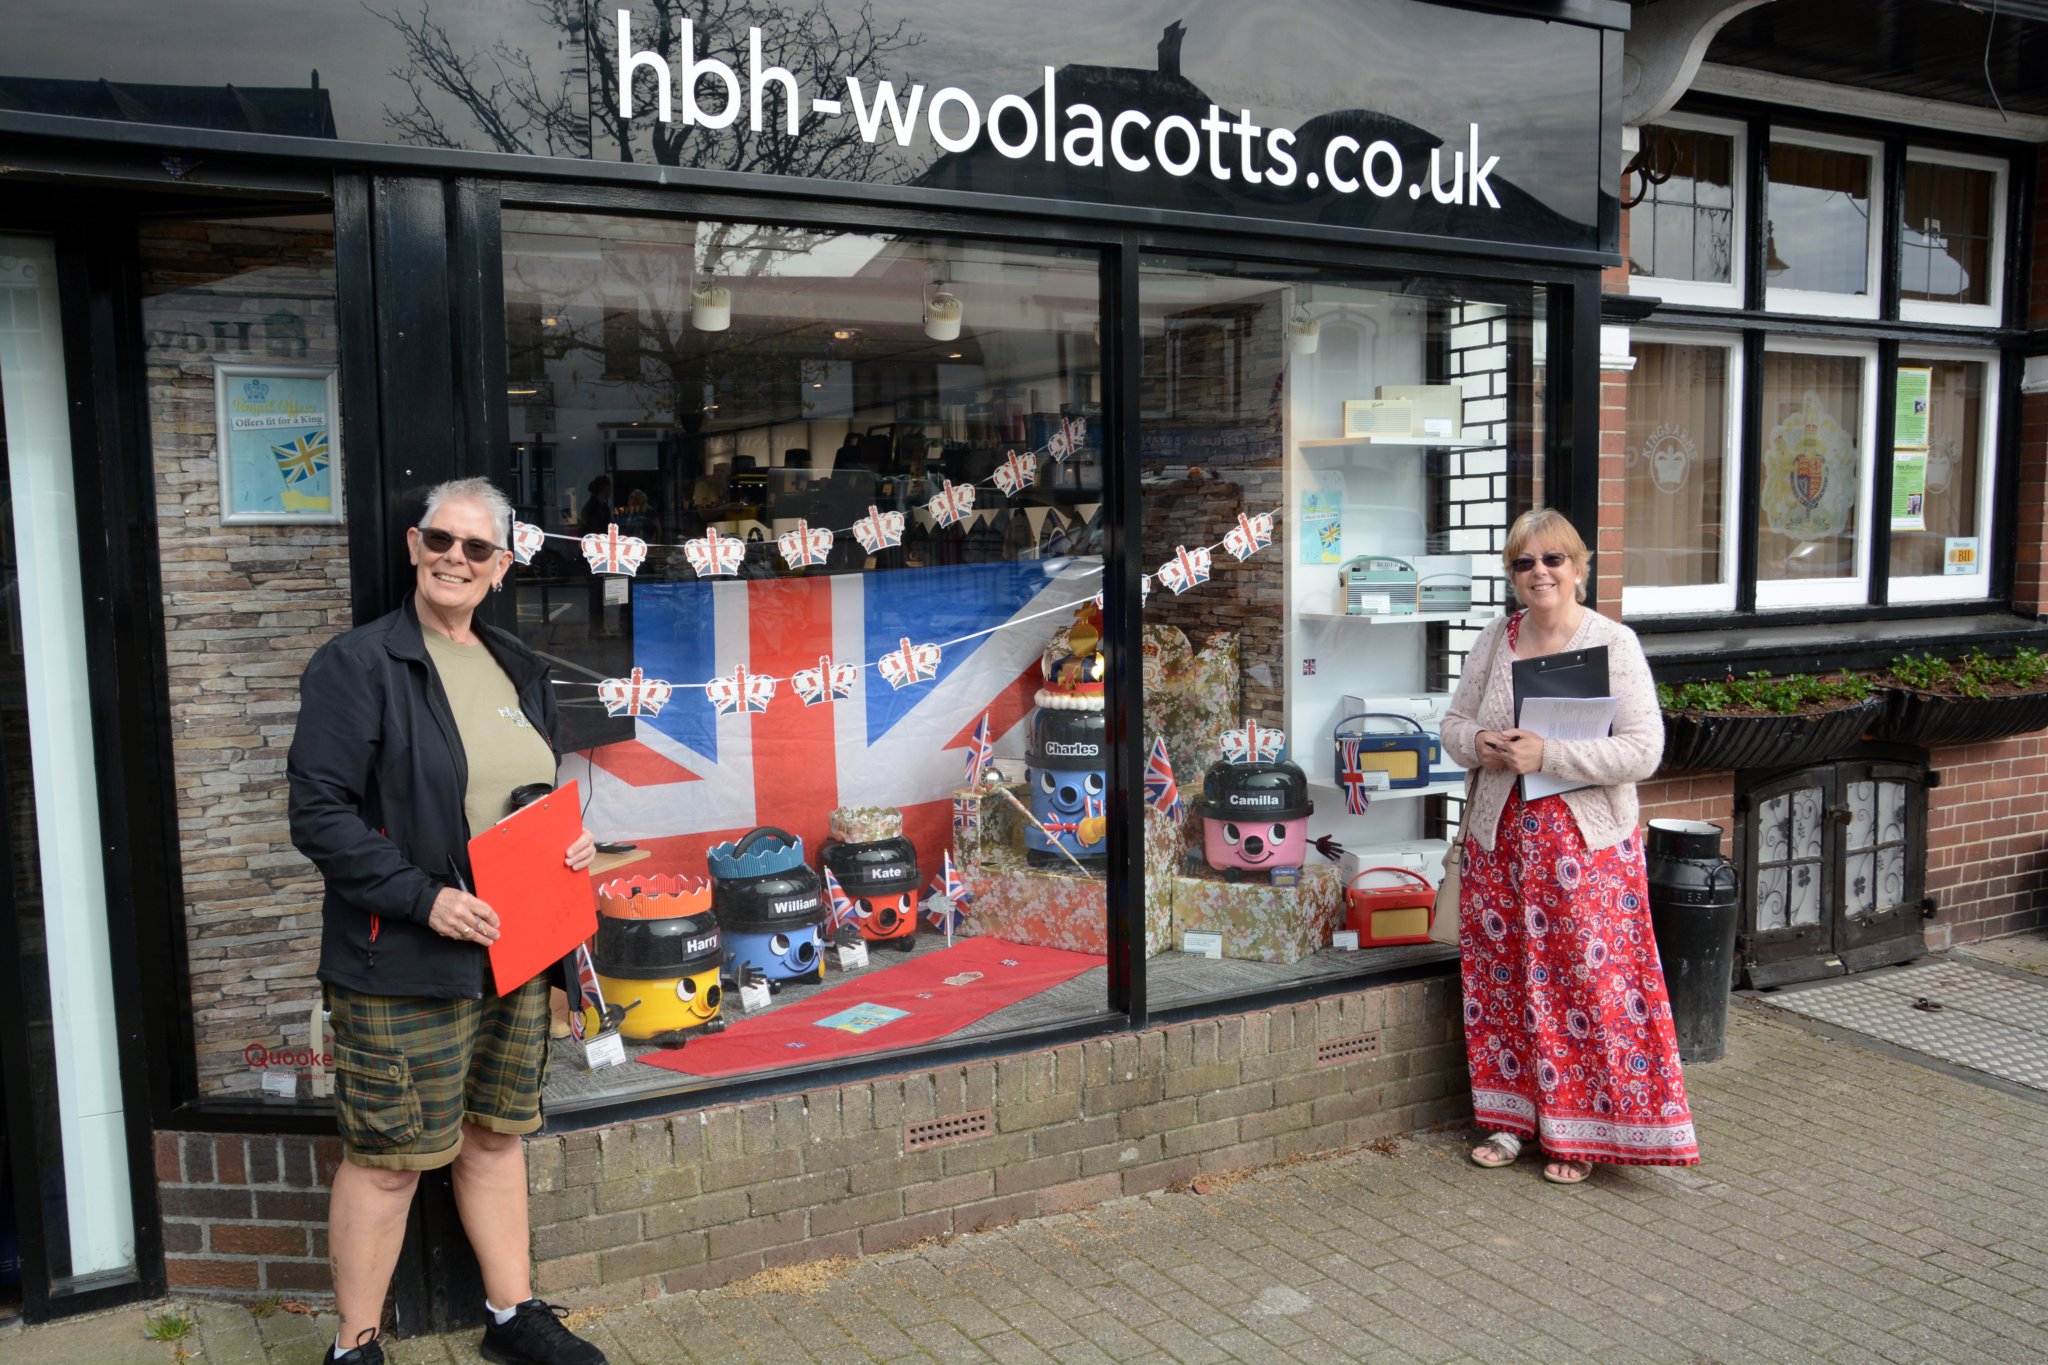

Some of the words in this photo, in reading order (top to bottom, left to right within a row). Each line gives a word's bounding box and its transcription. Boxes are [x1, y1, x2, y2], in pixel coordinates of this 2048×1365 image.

[617, 9, 1501, 209] hbh-woolacotts.co.uk
[235, 417, 264, 428] Offers
[266, 416, 276, 426] fit
[278, 415, 291, 425] for
[301, 415, 323, 426] King
[1045, 741, 1099, 757] Charles
[1229, 794, 1279, 806] Camilla
[871, 867, 902, 879] Kate
[774, 897, 817, 914] William
[686, 934, 718, 953] Harry
[245, 1043, 334, 1069] Quooke
